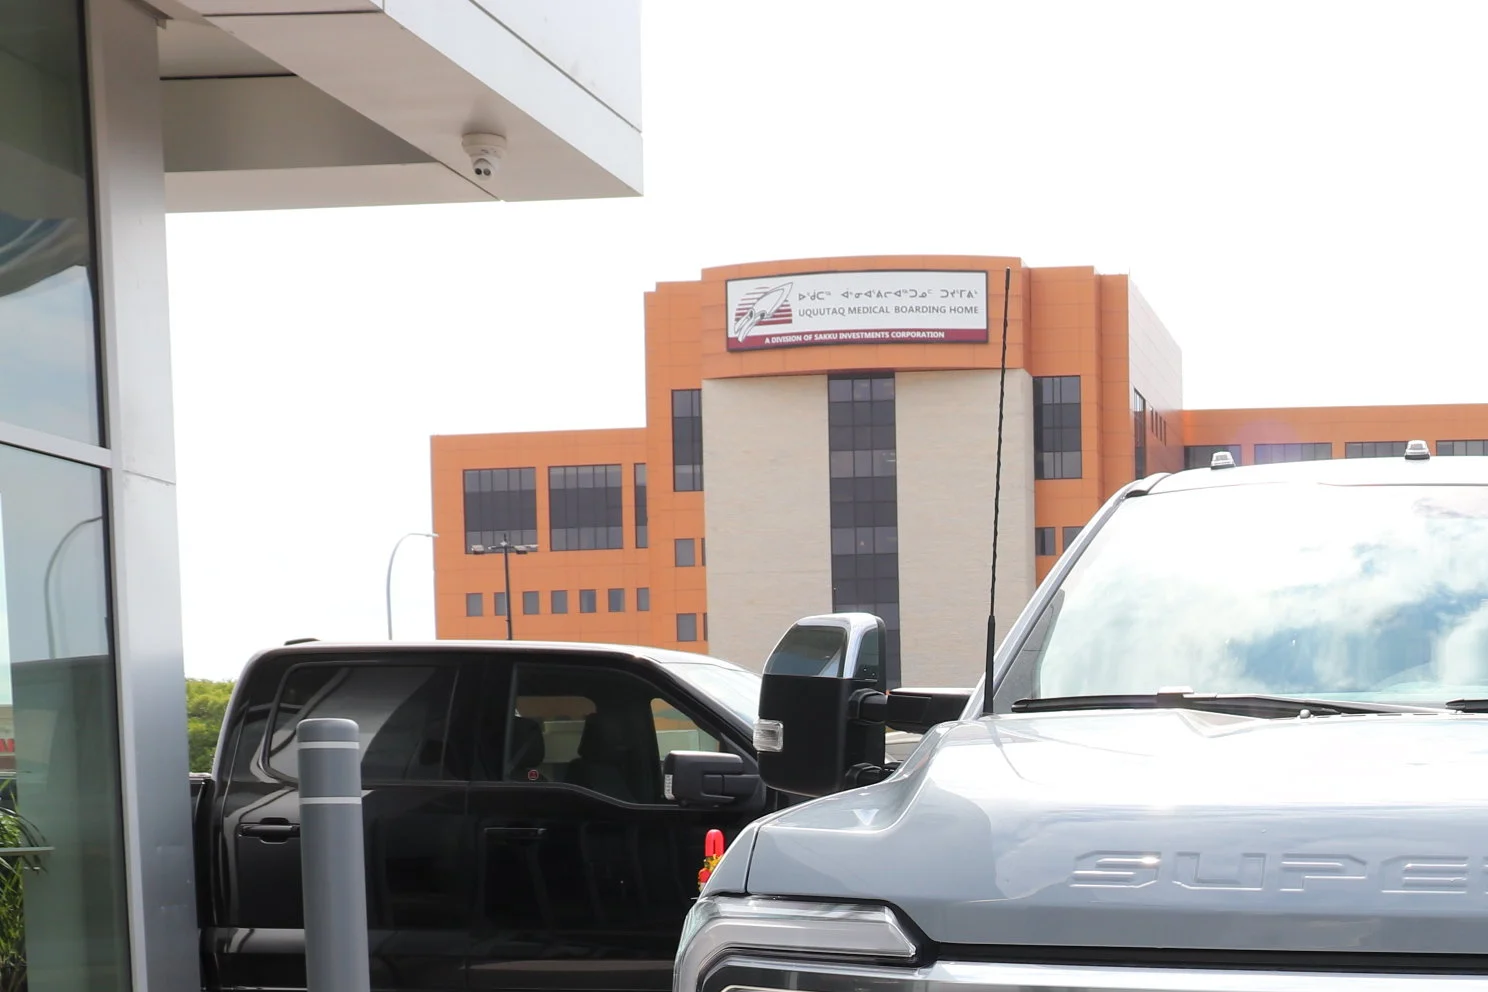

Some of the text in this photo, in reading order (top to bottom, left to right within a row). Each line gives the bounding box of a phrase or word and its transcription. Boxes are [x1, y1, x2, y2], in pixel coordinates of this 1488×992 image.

[798, 305, 979, 318] UQUUTAQ MEDICAL BOARDING HOME
[771, 335, 802, 343] DIVISION
[839, 331, 889, 339] INVESTMENTS
[891, 331, 945, 339] CORPORATION
